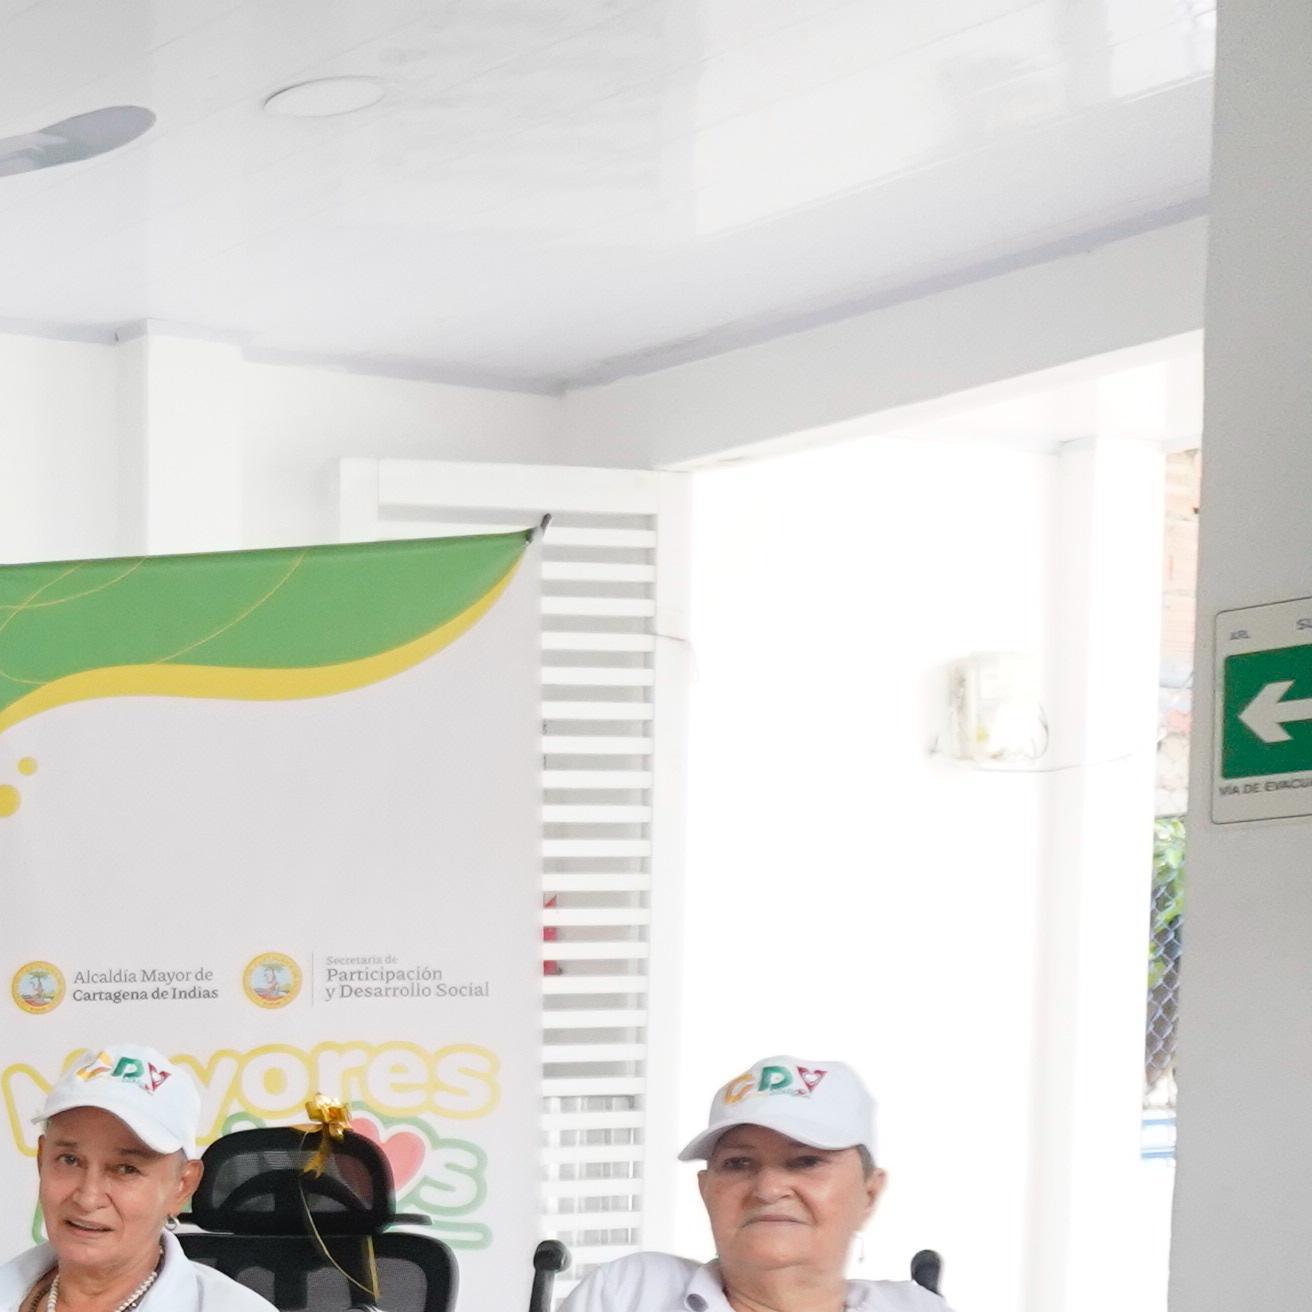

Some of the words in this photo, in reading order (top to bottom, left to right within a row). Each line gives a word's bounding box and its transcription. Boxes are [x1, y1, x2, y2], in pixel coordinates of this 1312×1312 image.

[384, 953, 398, 965] de
[141, 968, 191, 986] Mayor
[194, 967, 214, 982] de
[327, 966, 443, 983] Participación
[72, 987, 148, 1004] Cartagena
[151, 986, 169, 1000] de
[172, 985, 219, 1000] Indias
[325, 987, 336, 1002] y
[340, 983, 432, 999] Desarrollo
[435, 981, 490, 998] Social
[1, 1041, 500, 1157] Myores
